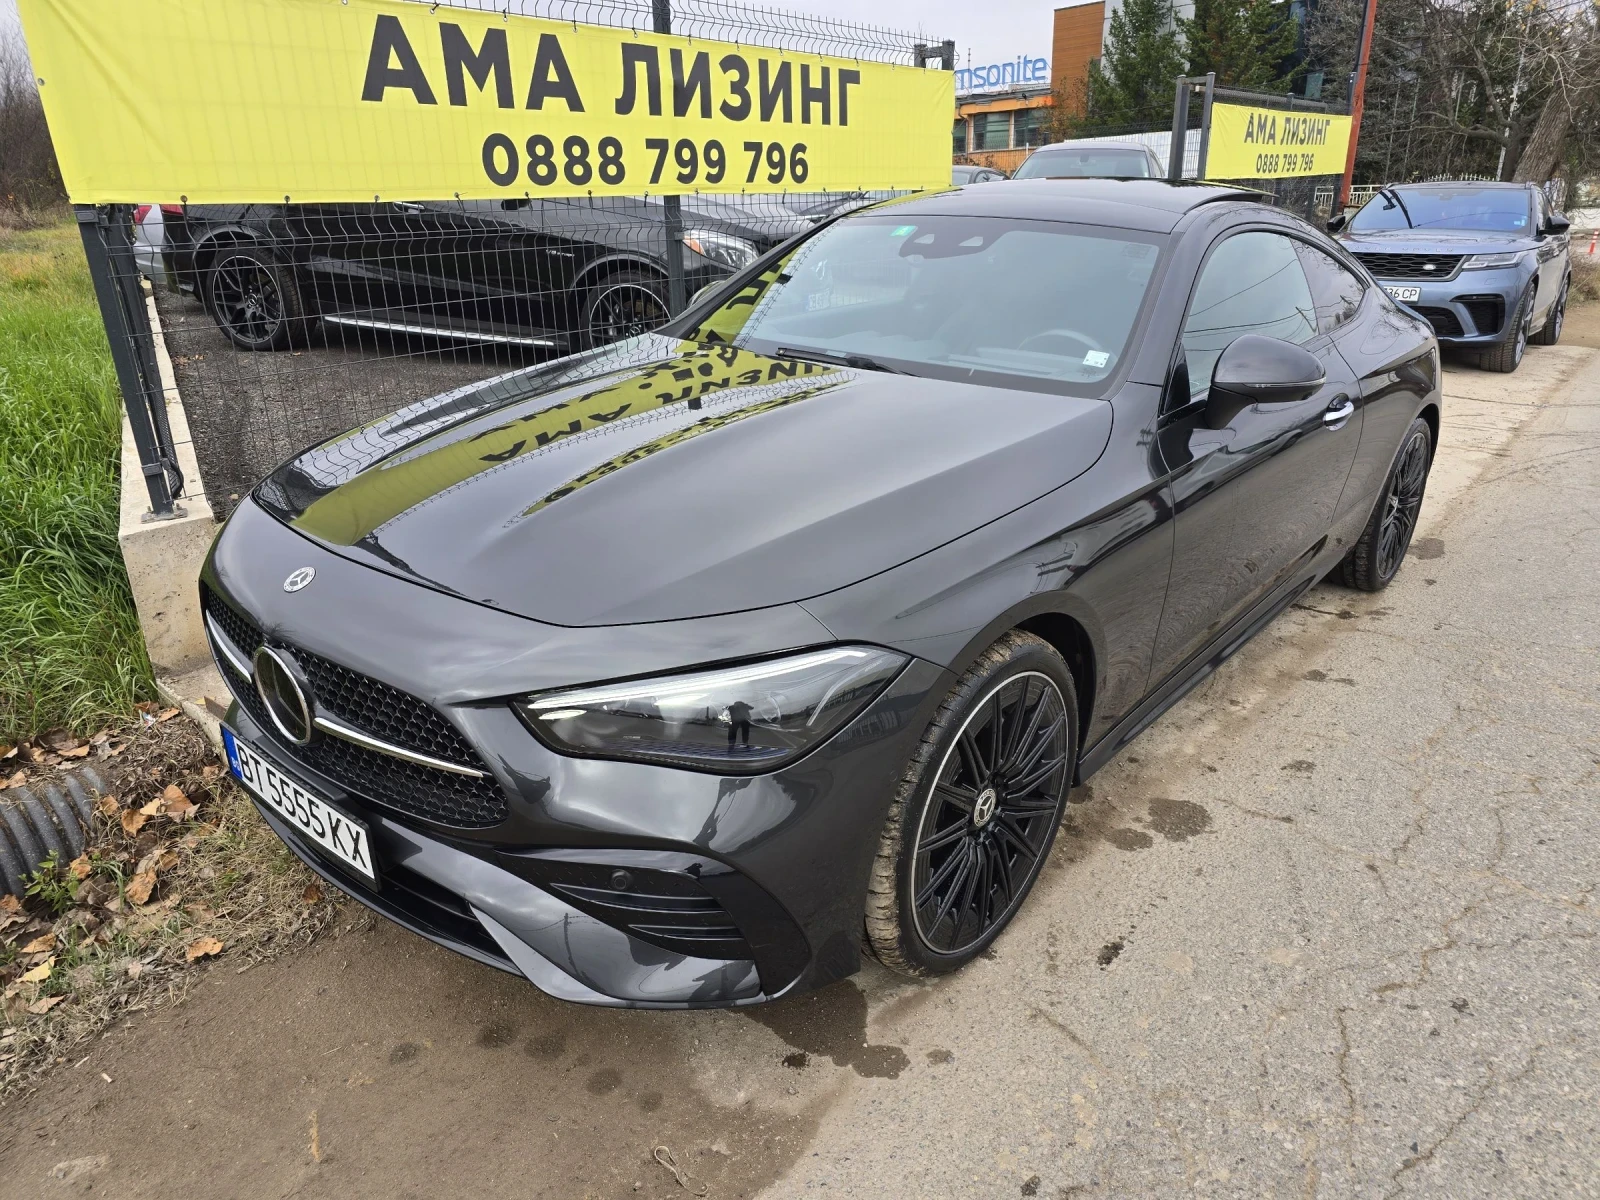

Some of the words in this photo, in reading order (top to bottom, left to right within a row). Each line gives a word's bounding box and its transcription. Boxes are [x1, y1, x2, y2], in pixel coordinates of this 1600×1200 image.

[361, 14, 586, 113] АМА
[615, 42, 861, 127] ЛИЗИНГ
[1244, 112, 1276, 145] АМА
[1280, 117, 1330, 145] ЛИЗИНГ
[482, 132, 626, 187] 0888
[645, 138, 727, 185] 799
[743, 141, 809, 184] 796
[1256, 153, 1280, 173] 0888
[1281, 153, 1298, 173] 799
[1299, 153, 1315, 172] 796
[1384, 288, 1400, 299] 36
[1402, 288, 1418, 300] CP
[237, 743, 264, 793] BT
[266, 767, 326, 839] 5555
[327, 811, 368, 870] KX
